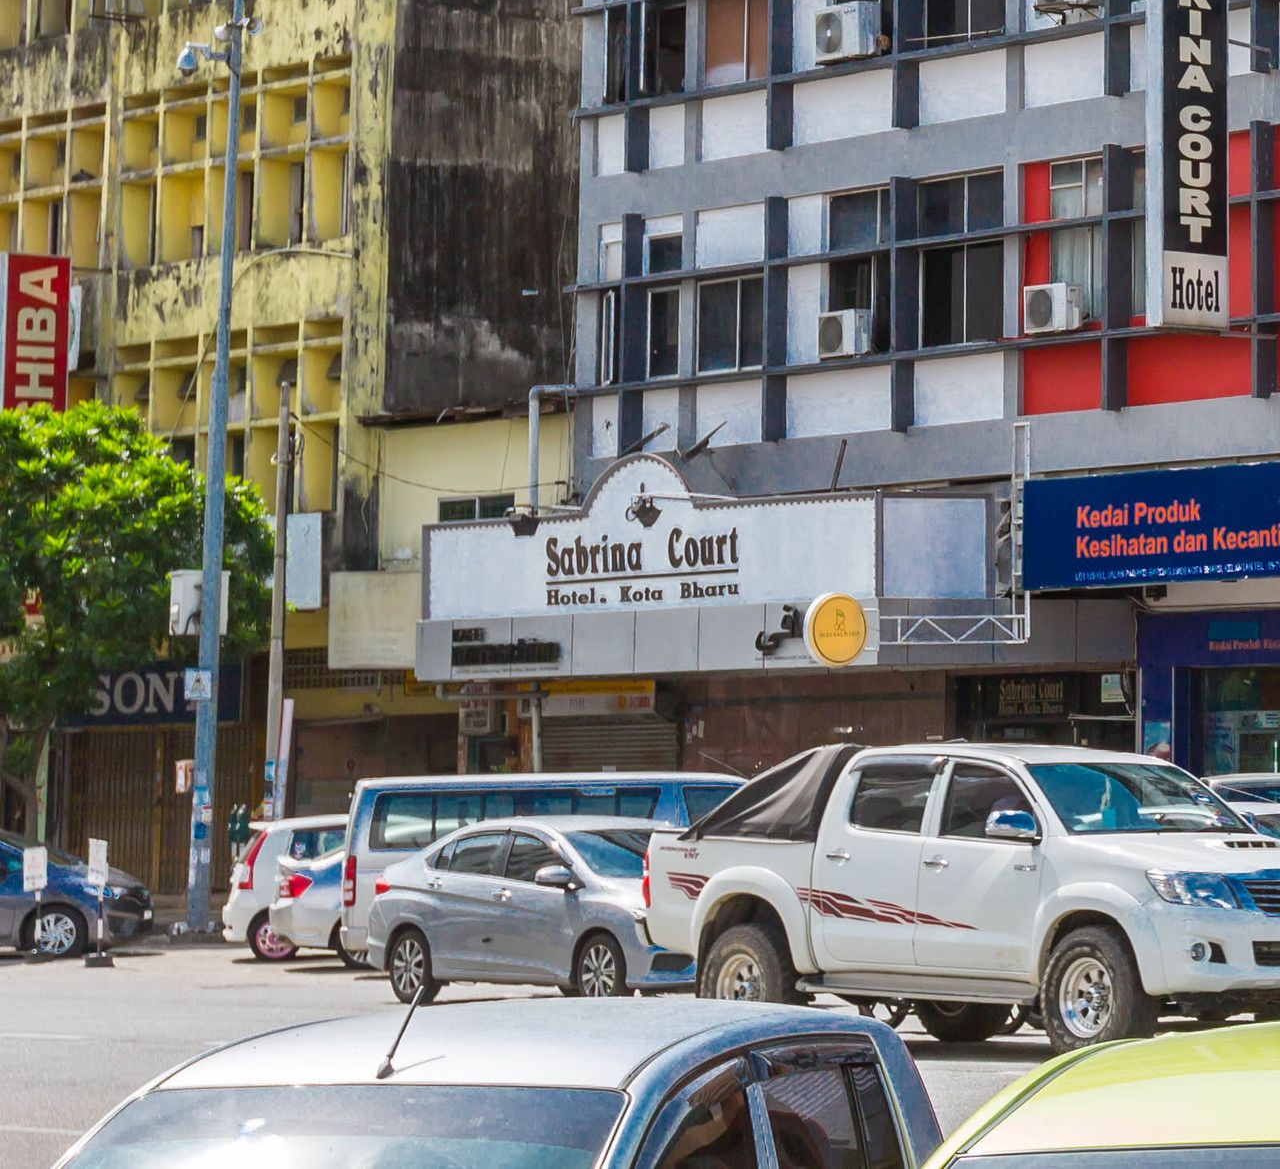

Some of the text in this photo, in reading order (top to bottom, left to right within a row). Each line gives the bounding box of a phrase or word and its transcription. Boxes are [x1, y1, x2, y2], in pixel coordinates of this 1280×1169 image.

[1178, 104, 1213, 244] COURT
[1170, 266, 1221, 314] Hotel
[14, 265, 59, 413] HIBA
[1076, 499, 1201, 528] Kedai Produk
[546, 527, 739, 577] Sabrina Court
[1076, 532, 1168, 559] Kesihatan
[1173, 530, 1207, 553] dan
[619, 584, 663, 603] Kota
[680, 581, 739, 598] Bharu
